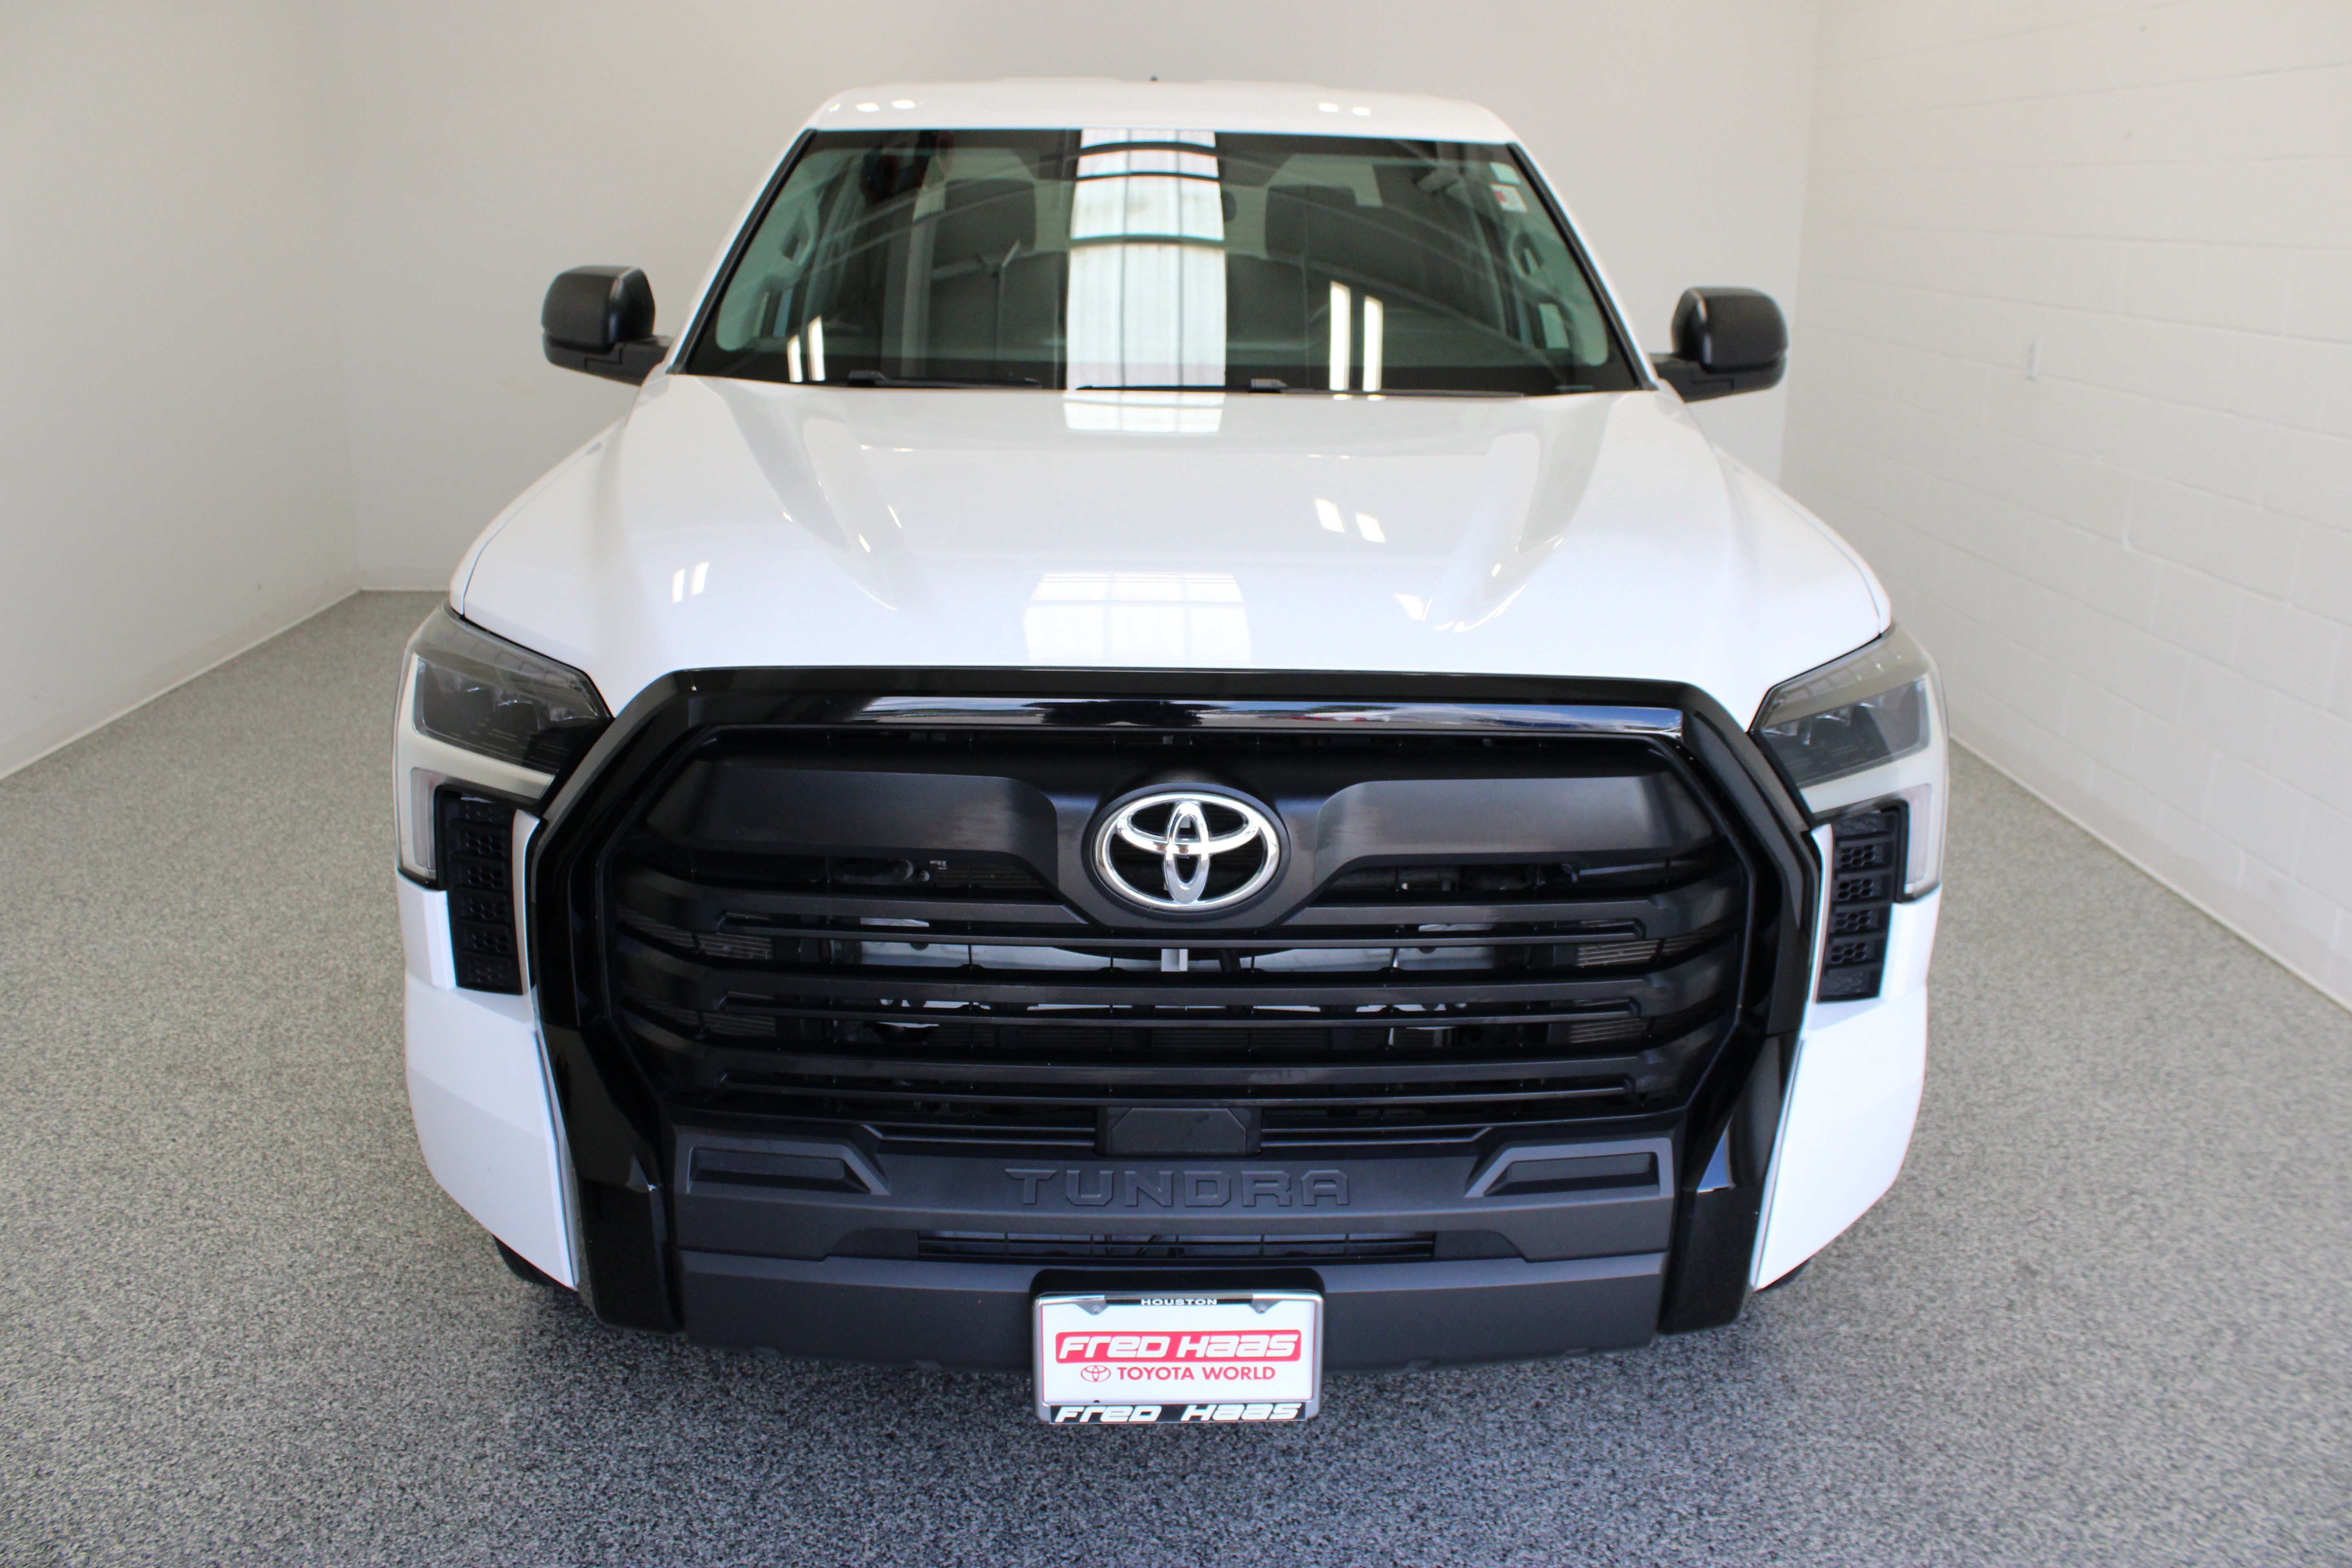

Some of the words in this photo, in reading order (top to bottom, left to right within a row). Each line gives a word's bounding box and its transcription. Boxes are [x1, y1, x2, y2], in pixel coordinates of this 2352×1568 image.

[1005, 1168, 1350, 1207] TUNDRA
[1117, 1366, 1195, 1381] TOYOTA
[1202, 1366, 1276, 1380] WORLD
